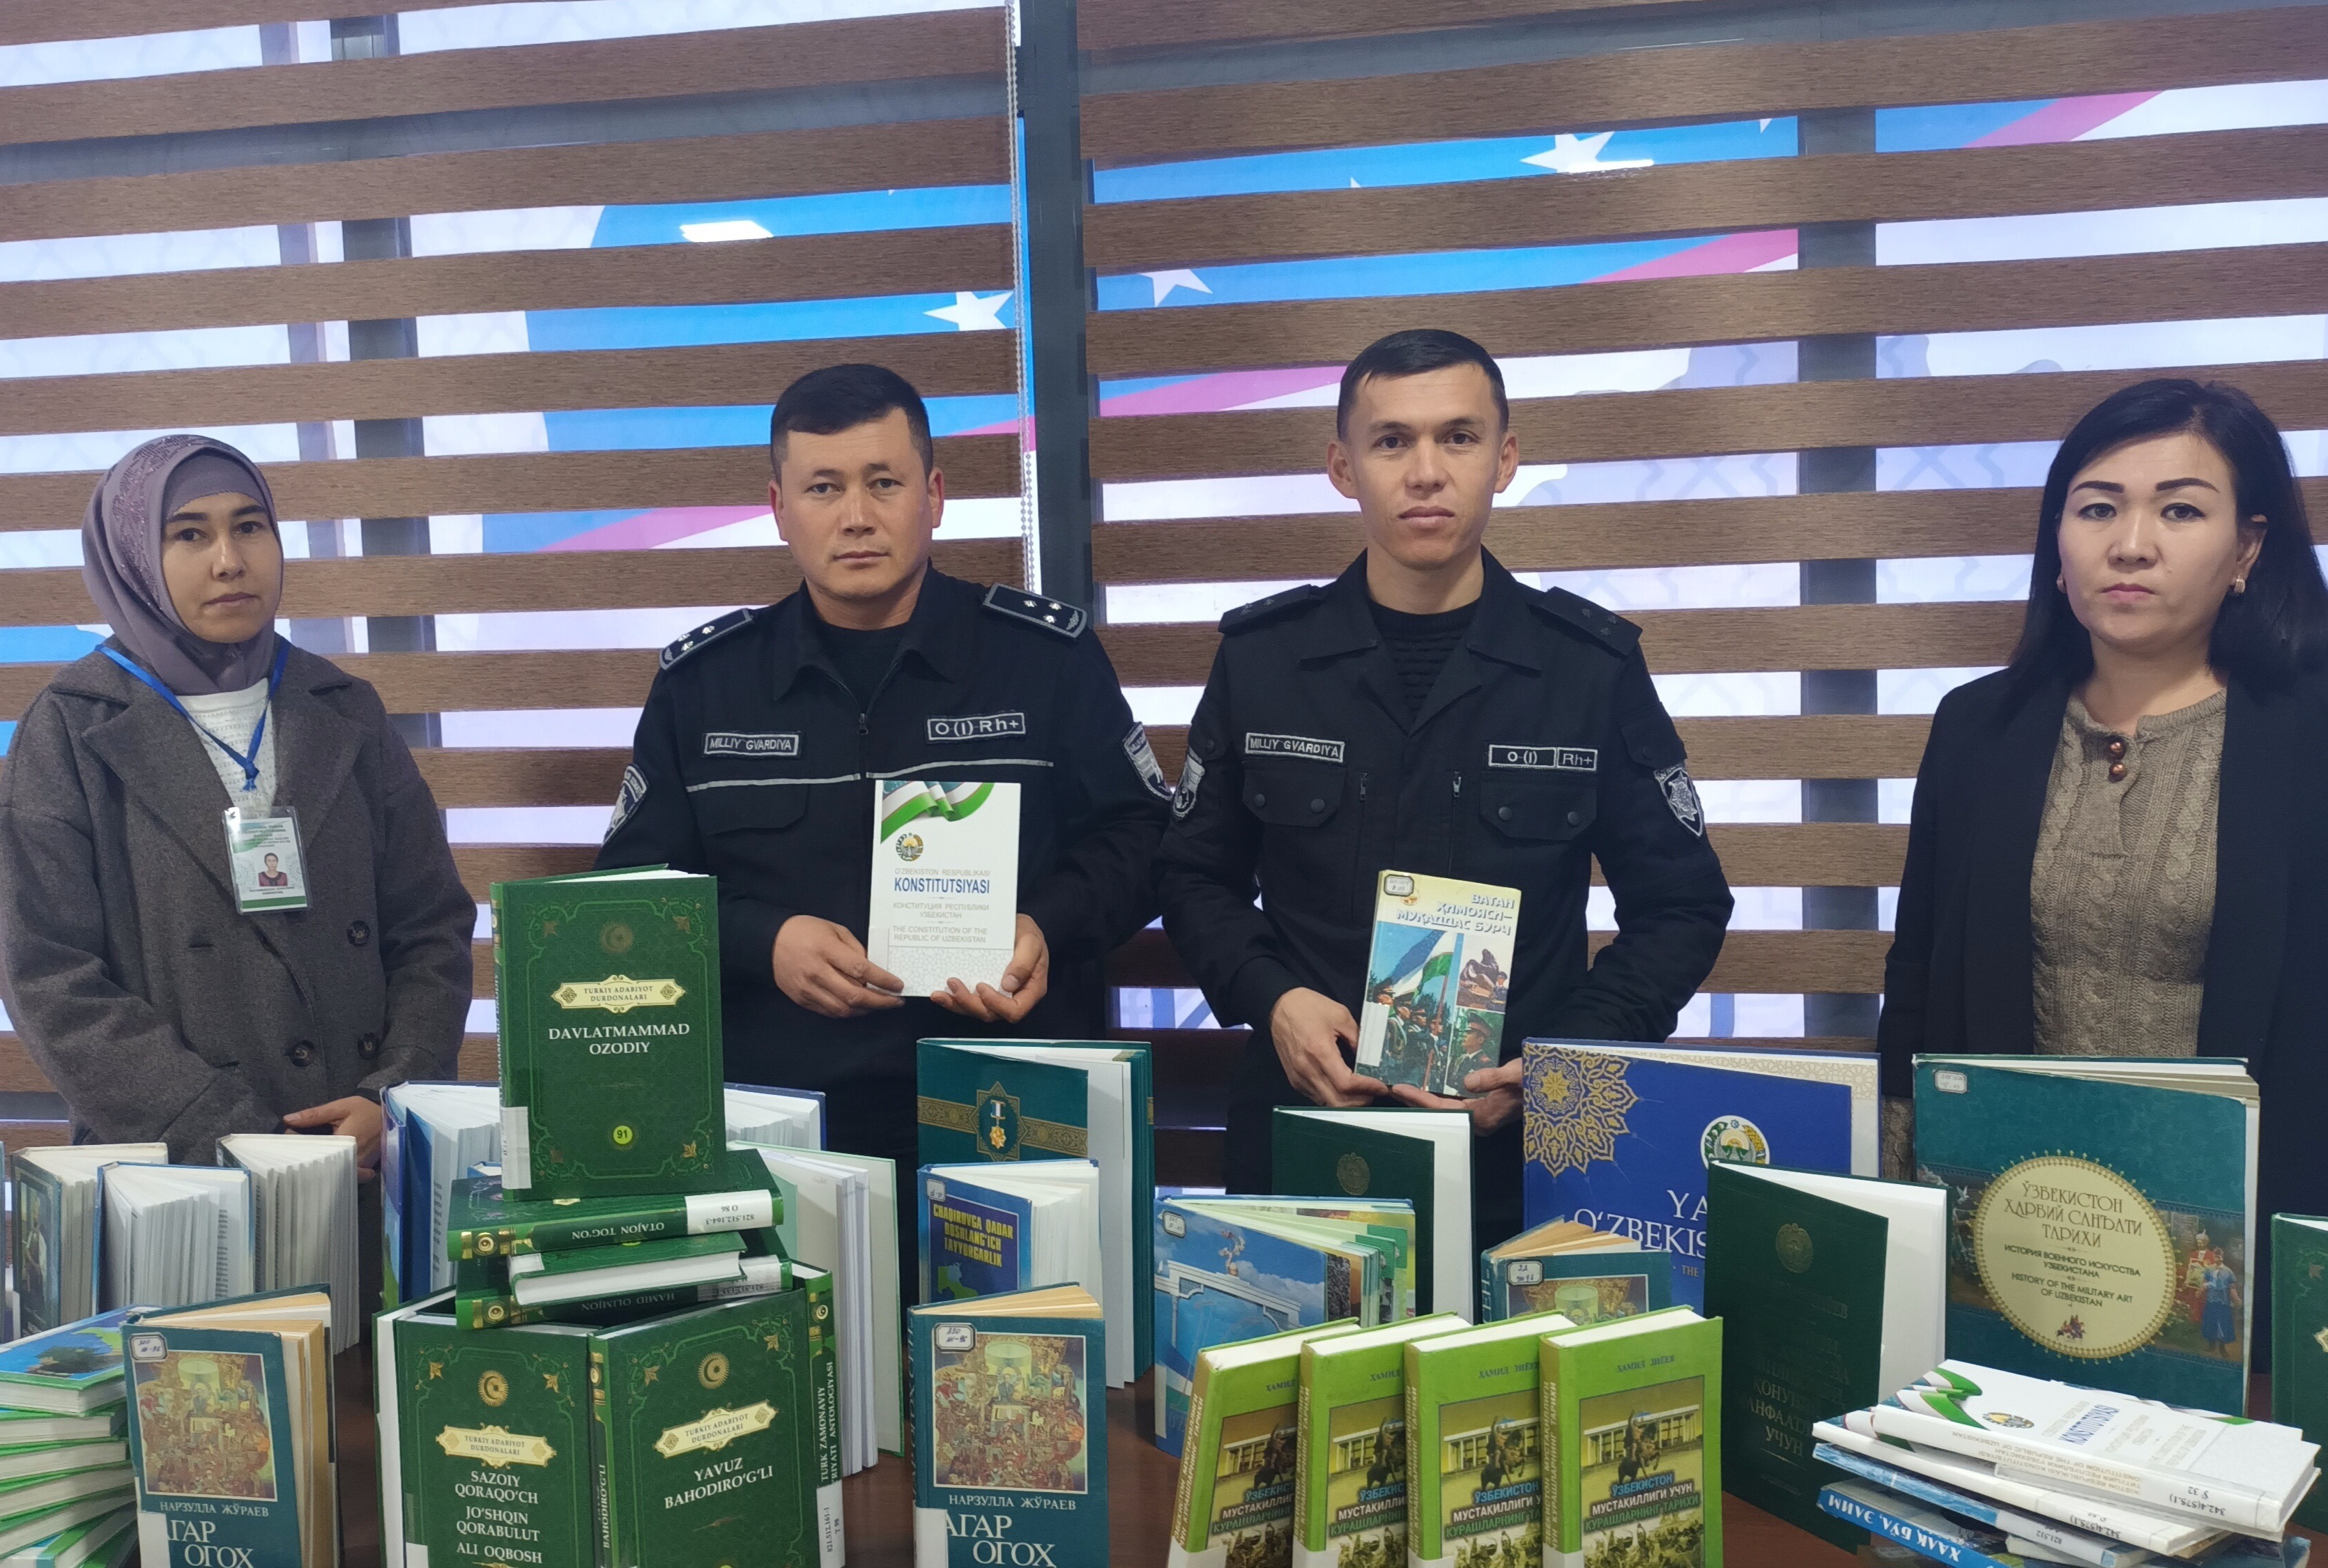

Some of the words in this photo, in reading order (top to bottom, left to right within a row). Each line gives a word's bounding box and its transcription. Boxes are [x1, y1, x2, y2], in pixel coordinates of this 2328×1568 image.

[710, 737, 741, 749] MILLIY
[745, 739, 792, 751] GVARDIYA
[1250, 737, 1280, 750] MILLIY
[1283, 740, 1339, 758] GVARDIYA
[894, 877, 990, 894] KONSTITUTSIYASI
[893, 902, 942, 910] КОНСТИТУЦИЯ
[1471, 893, 1515, 909] ВАТАН
[919, 911, 962, 919] УЗБЕКИСТАН
[908, 925, 960, 934] CONSTITUTION
[942, 935, 986, 943] UZBEKISTAN
[583, 986, 613, 994] TURKIY
[614, 985, 653, 994] ADABIYOT
[590, 993, 648, 1002] DURDONALARI
[549, 1022, 690, 1040] DAVLATMAMMAD
[589, 1041, 650, 1055] OZODIY
[616, 1129, 628, 1139] 91
[2022, 1180, 2123, 1214] ЎЗБЕКИСТОН
[620, 1222, 665, 1236] OTAJON
[933, 1204, 982, 1231] CHAQIRUVGA
[985, 1217, 1013, 1240] QADAR
[2068, 1210, 2143, 1236] САНЪАТИ
[1573, 1208, 1707, 1259] O'ZBEKIS
[2042, 1223, 2101, 1248] ТАРИХИ
[944, 1237, 1002, 1268] TAYYORGARLIK
[2004, 1244, 2043, 1258] ИСТОРИЯ
[2043, 1250, 2088, 1268] ВОЕННОГО
[2088, 1259, 2141, 1277] ИСКУССТВА
[1681, 1265, 1699, 1278] THE
[2043, 1260, 2100, 1279] УЗБЕКИСТАНА
[2012, 1272, 2045, 1288] HISTORY
[2046, 1279, 2058, 1290] OF
[2058, 1281, 2076, 1293] THE
[2077, 1284, 2115, 1300] MILITARY
[2116, 1292, 2134, 1304] ART
[2041, 1288, 2054, 1297] OF
[2055, 1289, 2103, 1308] UZBEKISTAN
[581, 1298, 631, 1312] OLIMJON
[636, 1292, 675, 1305] HAMID
[827, 1362, 838, 1438] ANTOLOGIYASI
[684, 1423, 712, 1438] TURKIY
[712, 1413, 749, 1429] ADABIYOT
[818, 1386, 828, 1449] ZAMONAVIY
[464, 1435, 489, 1445] TURKIY
[491, 1437, 525, 1448] ADABIYOT
[691, 1423, 744, 1444] DURDONALARI
[1765, 1425, 1804, 1457] УЧУН
[470, 1444, 521, 1456] DURDONALARI
[694, 1456, 744, 1482] YAVUZ
[820, 1454, 829, 1482] TURK
[2087, 1464, 2141, 1481] ONSTITUTION
[470, 1470, 521, 1488] SAZOIY
[1611, 1473, 1674, 1498] ЎЗБЕКИСТОН
[2108, 1482, 2139, 1495] KISTON
[949, 1494, 1015, 1507] НАРЗУЛЛА
[1020, 1496, 1076, 1511] ЖЎРАЕВ
[1359, 1483, 1405, 1502] ЎЗБЕКИС
[1591, 1487, 1668, 1517] МУСТАҚИЛЛИГИ
[1669, 1482, 1694, 1498] УЧУН
[160, 1501, 217, 1514] НАРЗУЛЛА
[221, 1502, 269, 1517] ЖЎРАЕВ
[1223, 1493, 1294, 1519] МУСТАҚИЛЛИГ
[1338, 1496, 1406, 1521] МУСТАҚИЛЛИ
[1453, 1498, 1533, 1523] МУСТАҚИЛЛИГИ
[1662, 1494, 1699, 1512] ТАРИХИ
[1828, 1493, 1876, 1524] ЭЛИМ
[2170, 1492, 2226, 1516] 342.4(575.1)
[167, 1519, 216, 1543] ГАР
[456, 1520, 541, 1542] QORABULUT
[456, 1542, 478, 1555] ALI
[484, 1545, 543, 1564] OQBOSH
